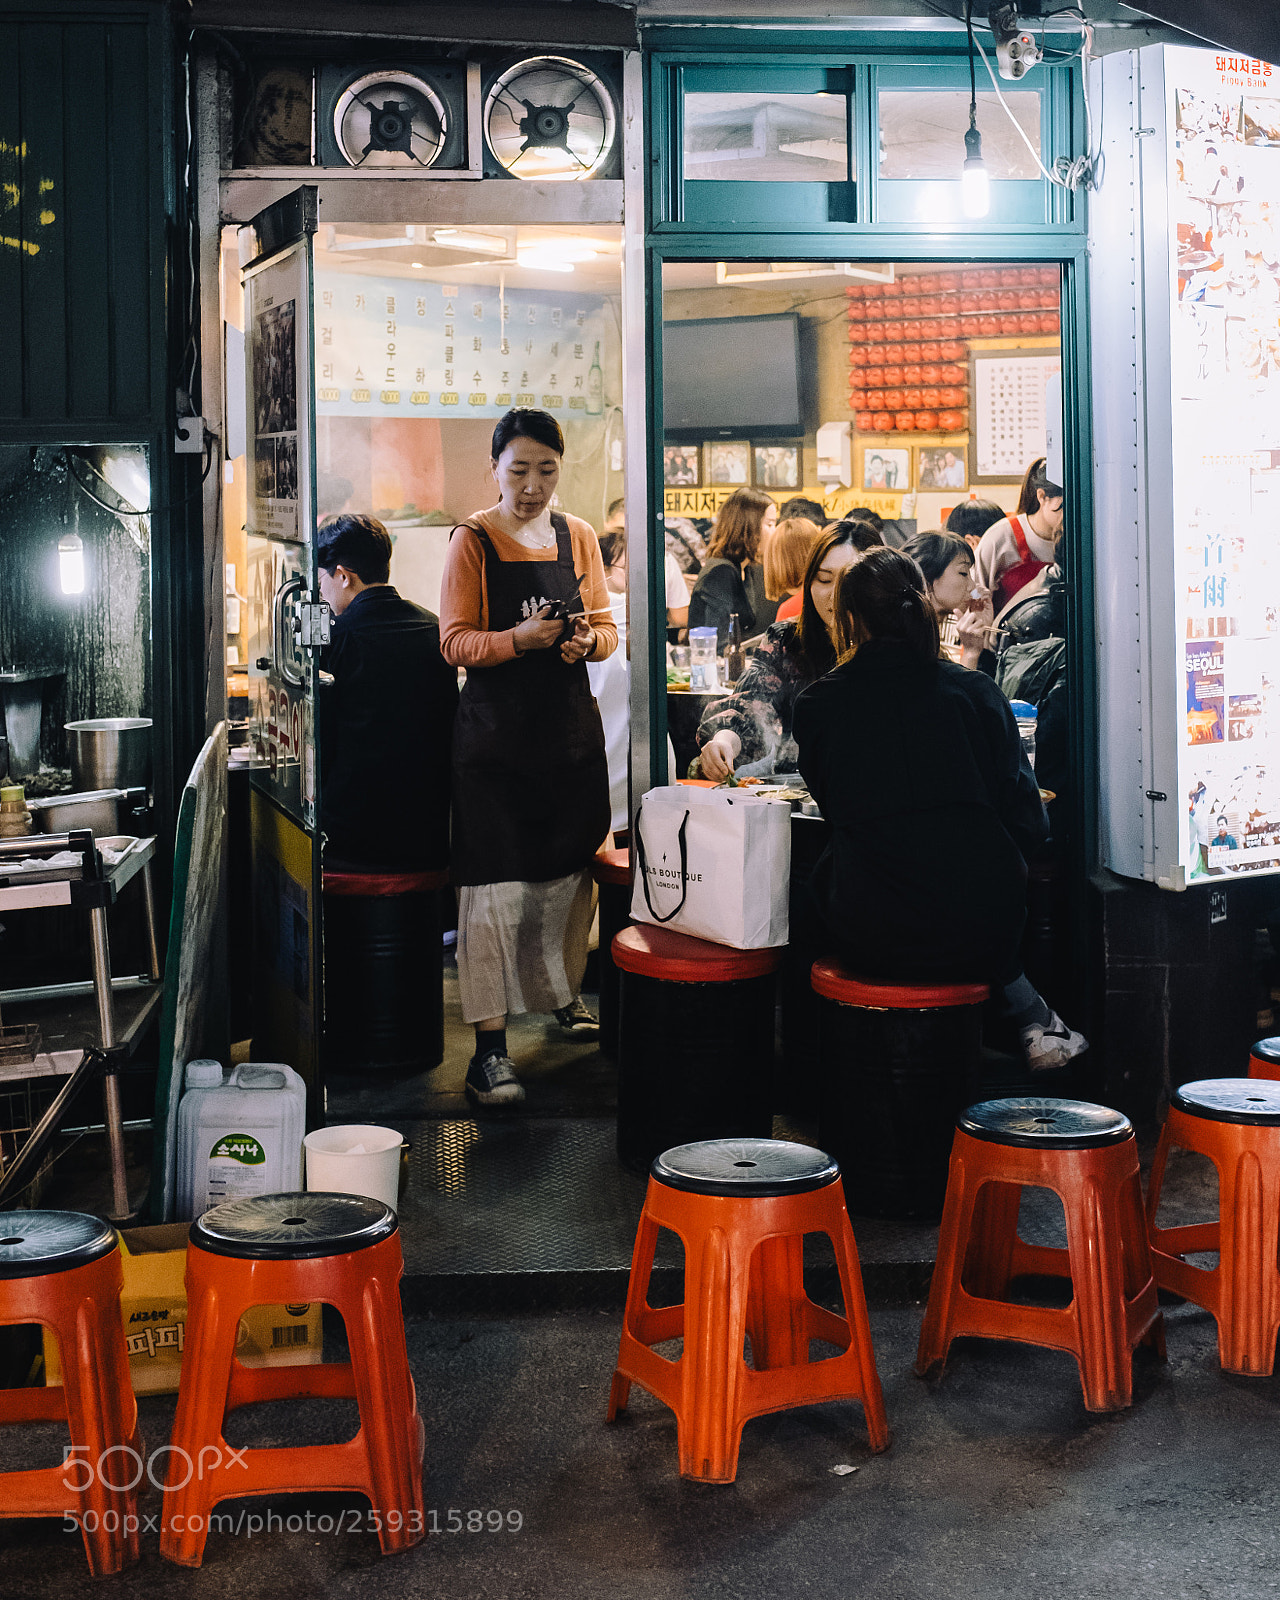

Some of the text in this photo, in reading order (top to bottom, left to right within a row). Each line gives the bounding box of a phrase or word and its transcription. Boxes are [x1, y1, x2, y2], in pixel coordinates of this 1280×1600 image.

[321, 291, 334, 381] 막걸리
[354, 293, 366, 381] 카스
[385, 296, 397, 383] 클라우드
[415, 297, 426, 385] 청하
[444, 301, 454, 387] 스파클링
[1185, 655, 1225, 673] SEOUL
[655, 880, 680, 890] LONDON
[659, 868, 703, 882] BOUTQUE
[217, 1143, 259, 1157] 소사나
